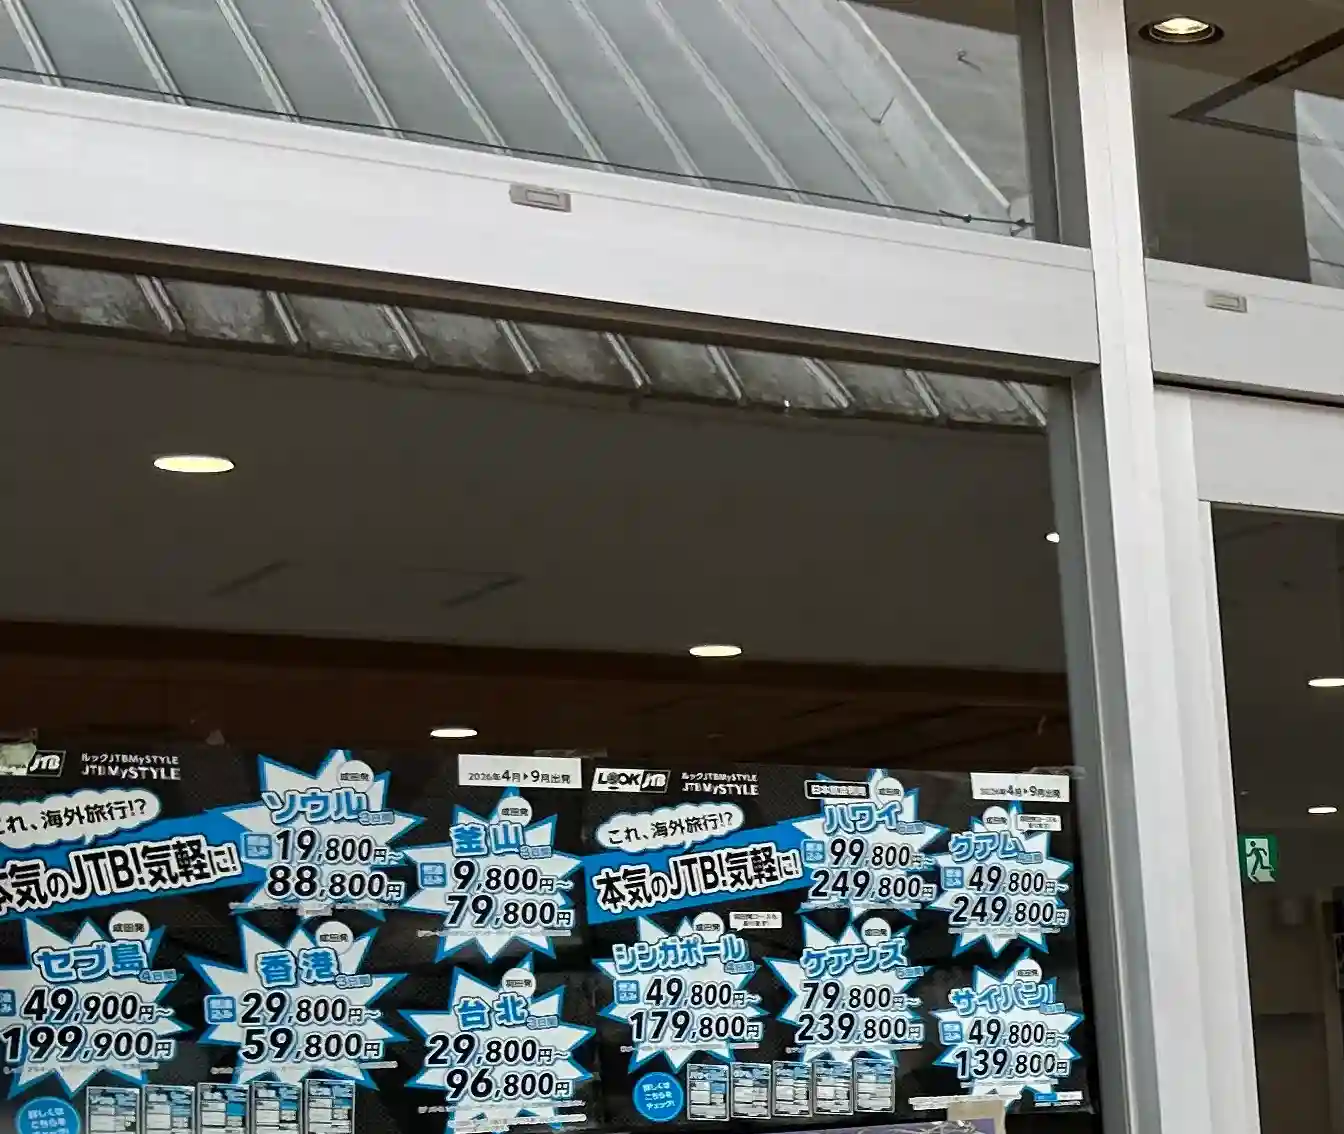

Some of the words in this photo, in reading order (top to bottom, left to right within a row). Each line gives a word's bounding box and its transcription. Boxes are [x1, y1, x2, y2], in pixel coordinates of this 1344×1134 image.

[30, 754, 60, 772] JTB
[262, 788, 367, 824] ソウル
[824, 801, 901, 834] ハワイ
[451, 821, 524, 856] 釜山
[950, 832, 1023, 861] グアム
[267, 865, 404, 899] 88,800円
[811, 869, 936, 899] 249,800円
[448, 895, 572, 926] 79,800円
[952, 896, 1068, 925] 249,800円
[34, 941, 148, 982] セブ島
[257, 947, 338, 987] 香港
[802, 938, 906, 977] ケアンズ
[454, 992, 528, 1031] 台北
[630, 1010, 761, 1040] 179,800円
[3, 1025, 173, 1062] 199,900円
[242, 1028, 382, 1061] 59,800円
[798, 1014, 922, 1043] 239,800円
[955, 1050, 1069, 1078] 139,800円
[446, 1068, 571, 1100] 96,800円
